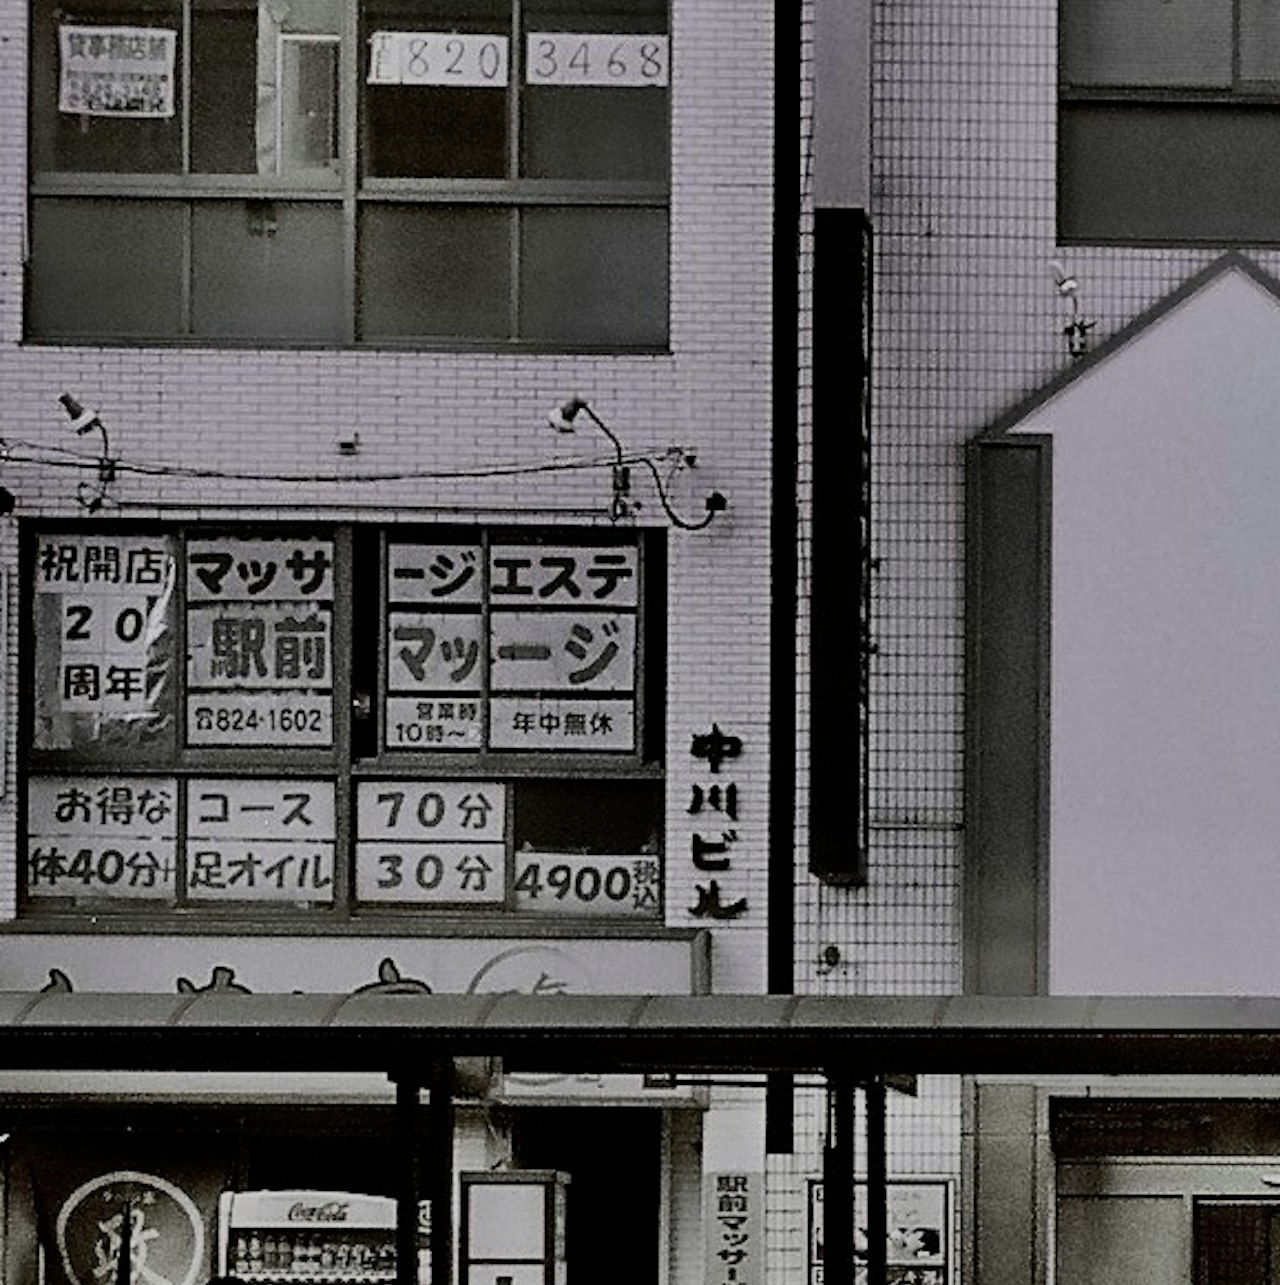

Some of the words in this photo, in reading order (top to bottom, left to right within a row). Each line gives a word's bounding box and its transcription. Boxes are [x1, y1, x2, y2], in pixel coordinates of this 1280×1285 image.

[407, 38, 499, 79] 820
[536, 40, 661, 78] 3468
[40, 544, 164, 584] 祝開店
[490, 554, 633, 598] エステ
[66, 604, 144, 643] 20
[211, 615, 326, 679] 駅前
[64, 664, 143, 701] 周年
[512, 711, 614, 735] 年中無休
[55, 787, 171, 825] お得な
[199, 793, 313, 825] コース
[377, 792, 493, 829] 70分
[687, 722, 750, 920] 中川ビル
[189, 851, 331, 888] 足オイル
[376, 854, 493, 891] 30分
[514, 863, 631, 900] 4900
